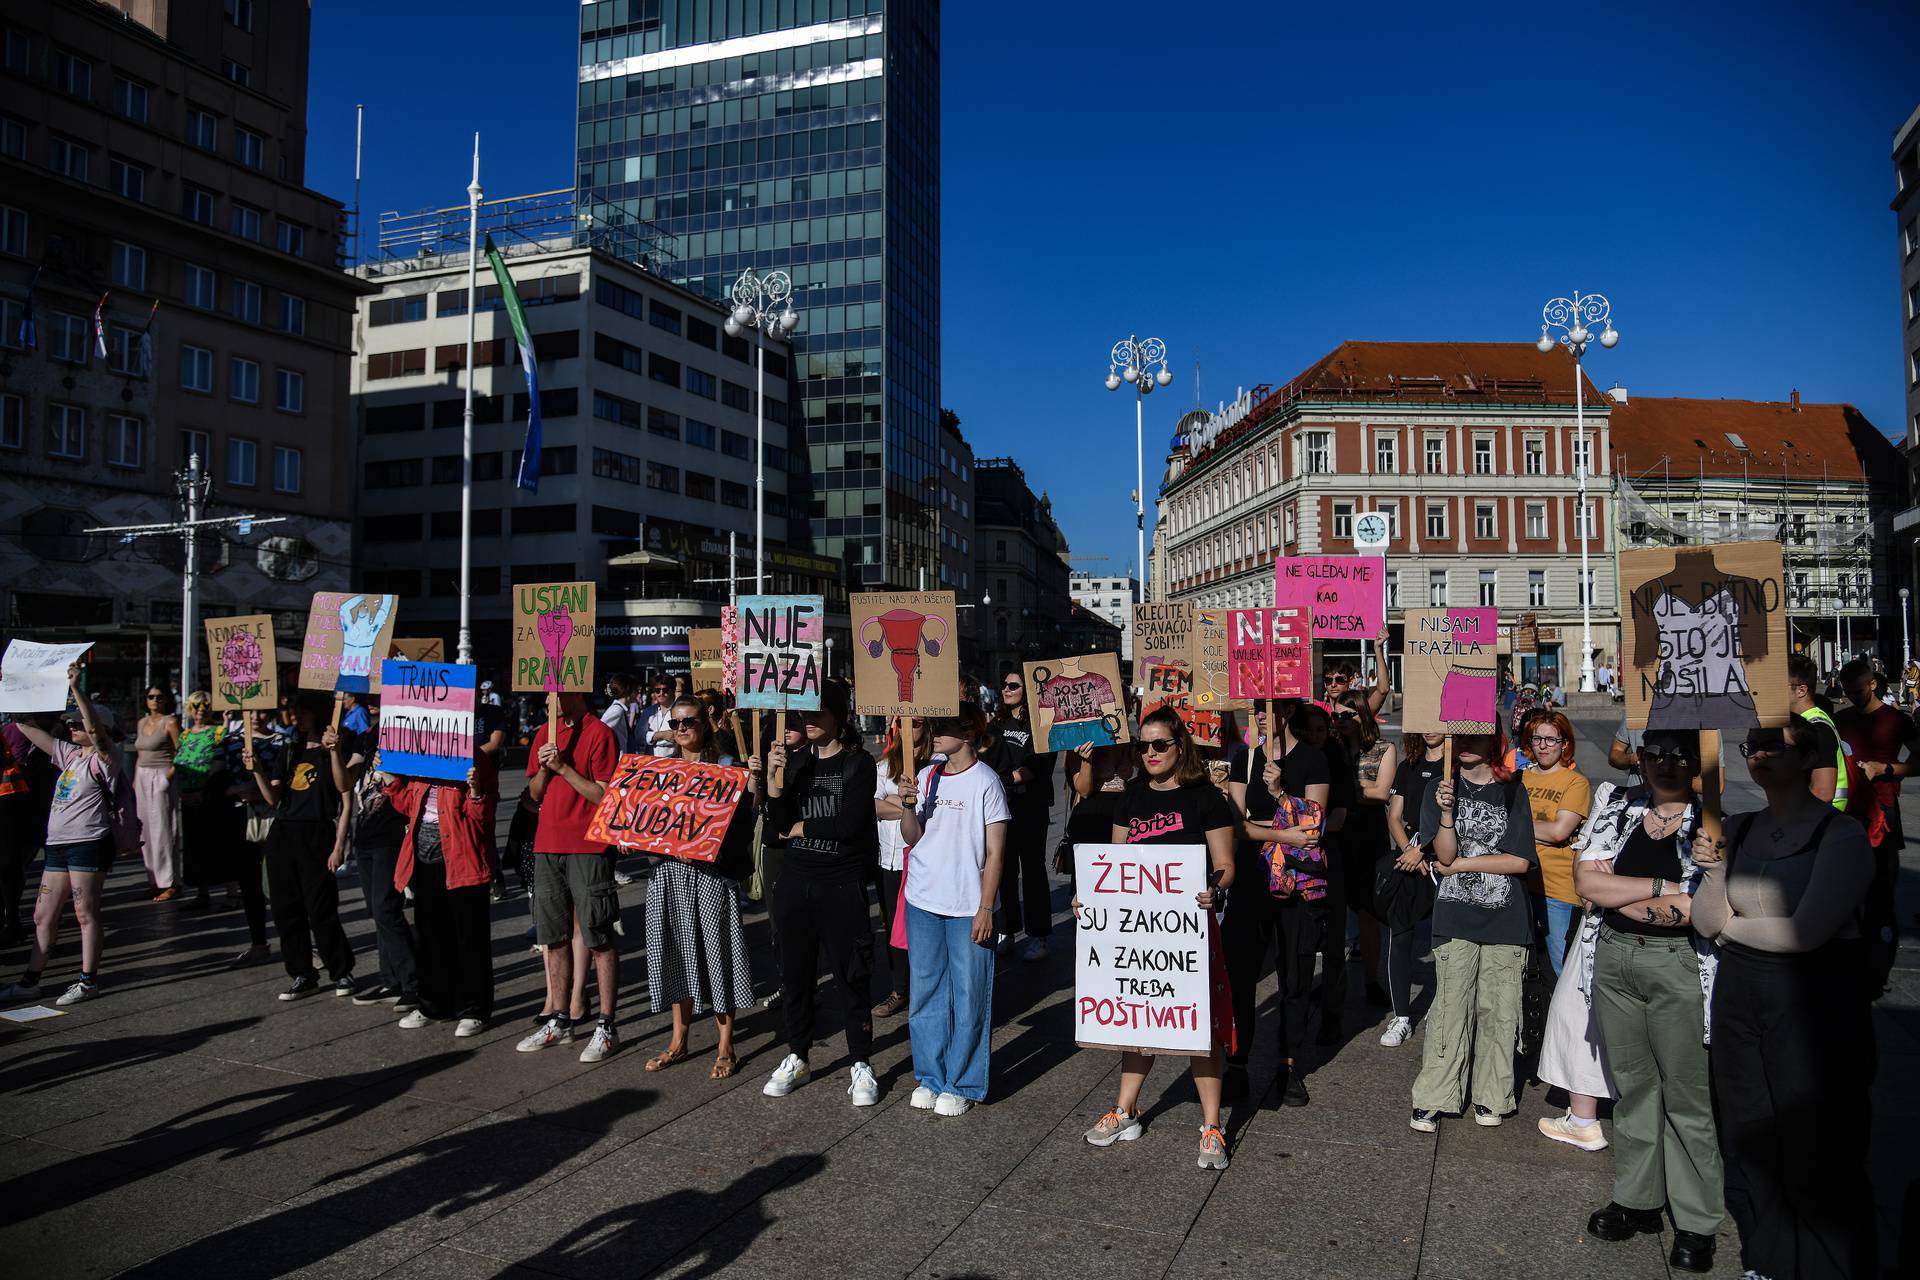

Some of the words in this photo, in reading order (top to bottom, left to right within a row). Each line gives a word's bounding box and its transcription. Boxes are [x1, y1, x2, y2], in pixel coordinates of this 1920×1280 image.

[1286, 565, 1302, 578] NE
[1306, 564, 1348, 579] GLEDAJ
[1352, 566, 1370, 581] ME
[520, 584, 589, 616] USTANI
[851, 595, 885, 605] PUSTITE
[889, 595, 906, 604] NAS
[910, 595, 922, 605] DA
[1316, 591, 1338, 603] KAO
[516, 626, 536, 642] ZA
[572, 624, 596, 638] SVOJA
[596, 623, 658, 637] ednostavno
[744, 604, 815, 649] NIJE
[1203, 626, 1225, 640] ŽENE
[1235, 608, 1301, 647] NE
[1419, 616, 1480, 633] NISAM
[1143, 634, 1185, 650] SOBI!!!
[1203, 645, 1225, 657] KOJE
[1231, 647, 1265, 661] UVIJEK
[1274, 645, 1302, 658] ZNAČI
[1656, 624, 1707, 661] ŠTO
[1715, 624, 1749, 659] JE
[694, 649, 721, 662] NJEZIN
[1202, 659, 1228, 672] SIGUR
[517, 655, 588, 686] PRAVA!
[743, 653, 820, 696] FAZA
[1150, 668, 1193, 693] FEM
[1237, 659, 1302, 697] NE
[398, 665, 450, 703] TRANS
[1053, 681, 1096, 697] DOSTA
[857, 705, 887, 715] PUSTITE
[890, 705, 905, 715] NAS
[908, 706, 919, 715] DA
[1057, 694, 1071, 708] MI
[1078, 693, 1092, 707] JE
[620, 762, 681, 794] ŽENA
[686, 771, 739, 804] ŽENI
[609, 799, 714, 842] LJUBAV
[1127, 811, 1178, 839] Borba
[1091, 853, 1184, 896] ŽENE
[1080, 907, 1108, 932] SU
[1119, 908, 1205, 940] ZAKON,
[1088, 945, 1101, 968] A
[1114, 946, 1199, 973] ZAKONE
[1115, 976, 1176, 999] TREBA
